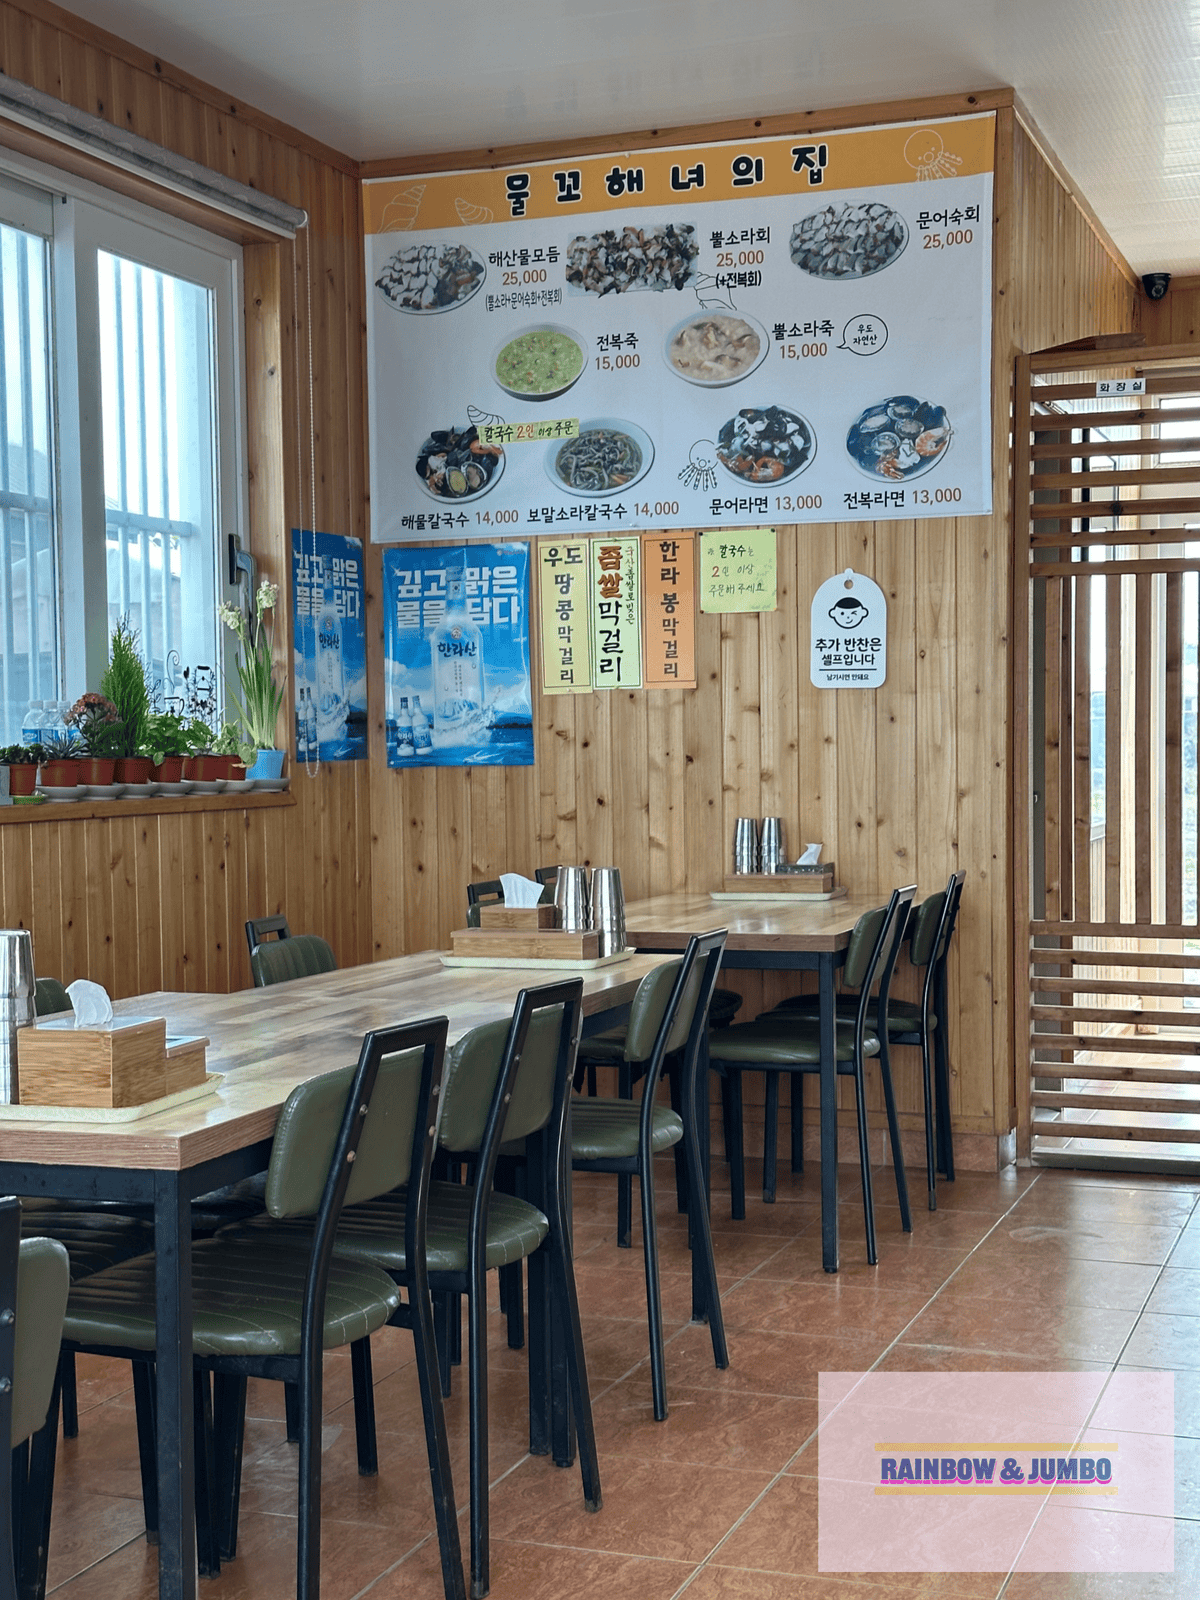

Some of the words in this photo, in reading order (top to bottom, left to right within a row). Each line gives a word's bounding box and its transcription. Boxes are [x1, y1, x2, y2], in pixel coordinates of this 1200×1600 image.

[916, 204, 979, 230] 문어숙회
[709, 226, 770, 249] 뿔소라회
[923, 229, 973, 250] 25,000
[488, 245, 561, 268] 해산물모듬
[716, 250, 764, 268] 25,000
[502, 269, 547, 287] 25,000
[716, 270, 762, 289] (+전복회)
[772, 320, 834, 341] 뿔소라죽
[857, 324, 874, 334] 우도
[596, 332, 639, 352] 전복죽
[780, 342, 828, 360] 15,000
[853, 335, 878, 346] 자연산
[595, 354, 640, 371] 15,000
[484, 425, 514, 443] 칼국수
[516, 424, 535, 439] 2인
[554, 420, 573, 436] 주문
[709, 496, 768, 515] 문어라면
[774, 494, 823, 512] 13,000
[843, 490, 905, 510] 전복라면
[912, 487, 962, 506] 13,000
[401, 511, 470, 530] 해물칼국수
[475, 509, 519, 526] 14,000
[527, 503, 628, 524] 보말소라칼국수
[634, 501, 680, 518] 14,000
[544, 547, 583, 567] 우도
[332, 557, 359, 590] 맑은
[395, 568, 447, 598] 깊고
[465, 565, 518, 595] 맑은
[333, 589, 360, 619] 담다
[465, 596, 521, 625] 담다
[659, 541, 680, 678] 한라봉막걸리
[437, 641, 477, 657] 한라산
[815, 637, 840, 652] 추가
[844, 637, 882, 652] 반찬은
[821, 653, 875, 666] 셀프입니다
